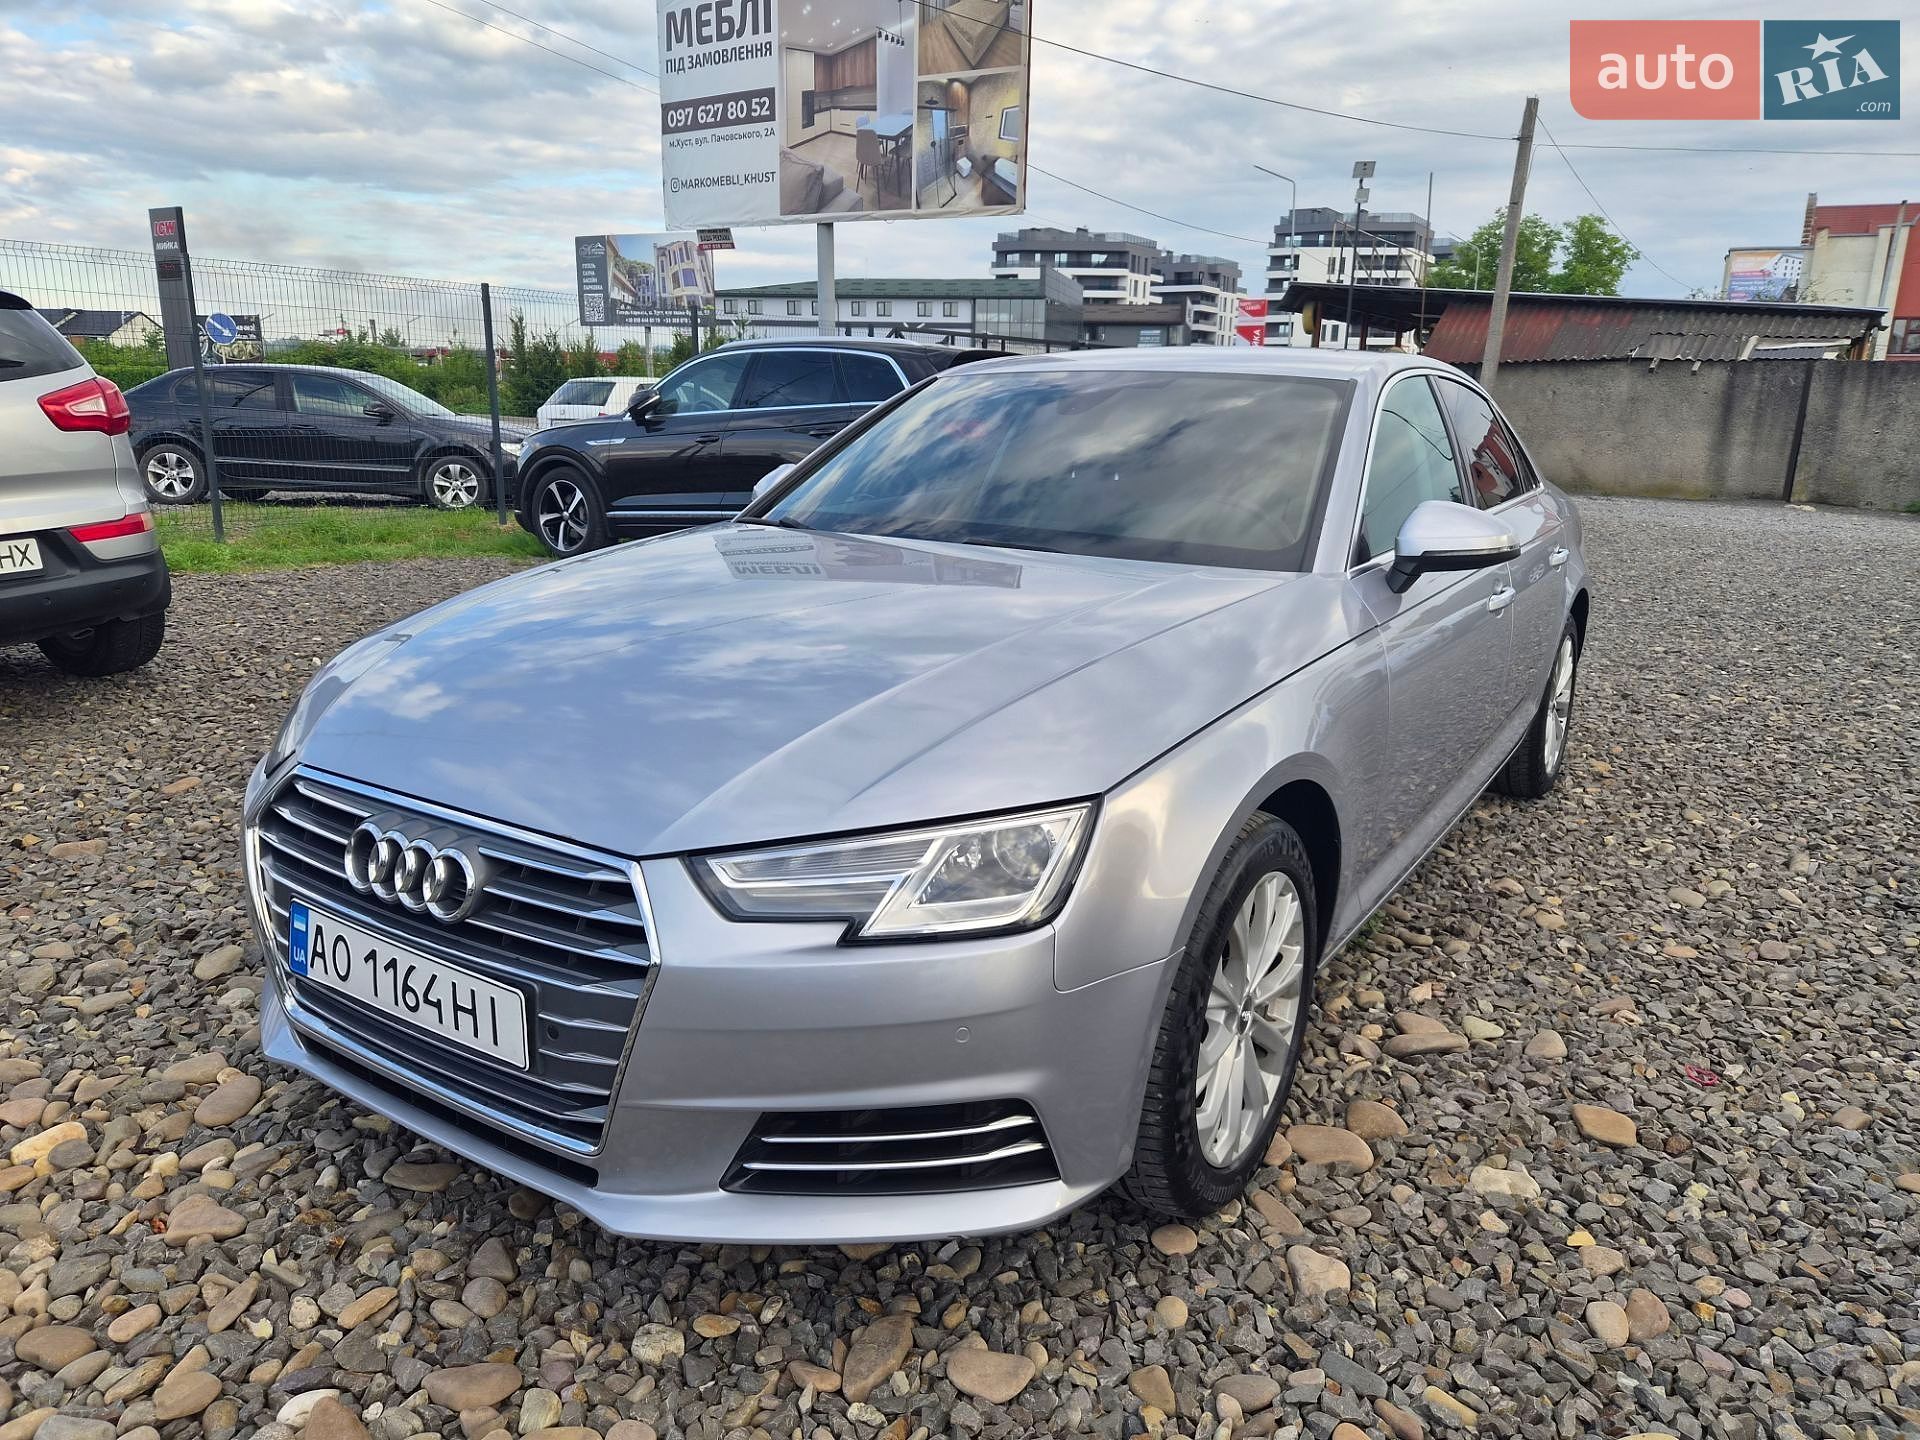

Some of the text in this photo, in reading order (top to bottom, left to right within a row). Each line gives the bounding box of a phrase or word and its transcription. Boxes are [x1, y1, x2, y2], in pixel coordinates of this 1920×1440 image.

[666, 0, 771, 51] МЕБЛІ
[665, 41, 773, 75] ПІД ЗАМОВЛЕННЯ
[667, 96, 770, 128] 097 627 80 52
[294, 944, 306, 965] UA
[309, 924, 351, 983] AO
